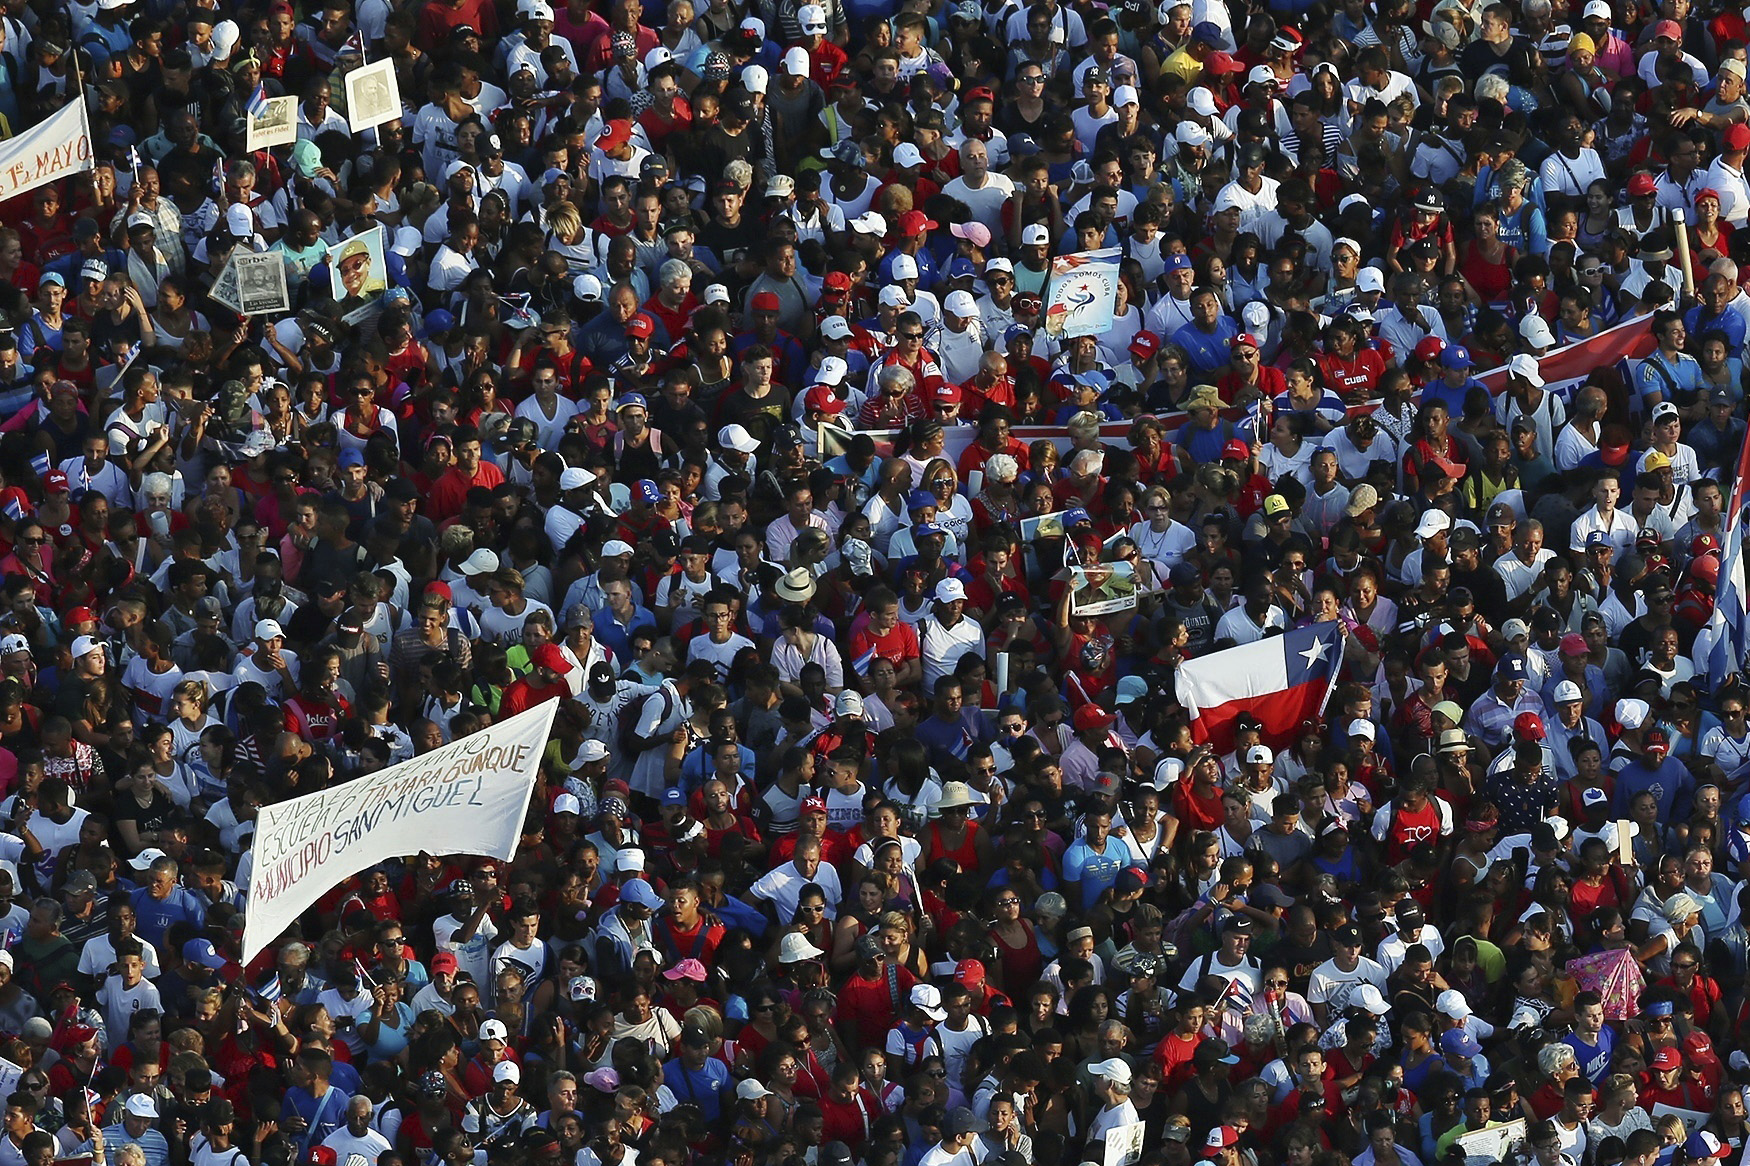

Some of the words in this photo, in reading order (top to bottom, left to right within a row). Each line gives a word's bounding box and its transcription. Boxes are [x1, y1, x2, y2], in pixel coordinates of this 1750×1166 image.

[274, 126, 289, 134] Fidel
[34, 135, 89, 179] MAYO
[1101, 278, 1111, 297] CUBA
[1344, 374, 1368, 386] CUBA
[269, 793, 326, 826] VIVA
[806, 798, 823, 808] NY
[1586, 1051, 1606, 1073] NIKE
